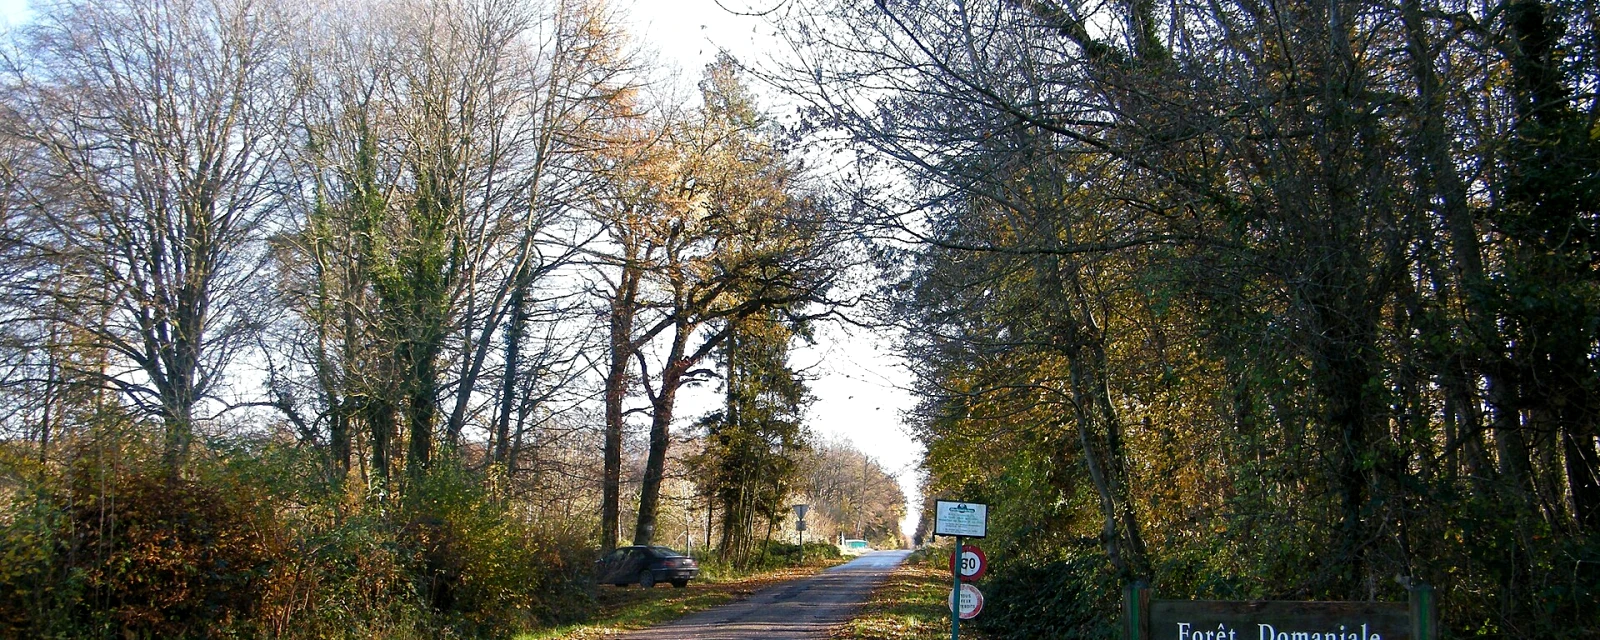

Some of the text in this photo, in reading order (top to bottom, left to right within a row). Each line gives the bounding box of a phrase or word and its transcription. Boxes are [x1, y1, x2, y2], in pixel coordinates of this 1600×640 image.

[961, 557, 976, 570] 60
[1177, 622, 1381, 640] Forêt Domaniale
